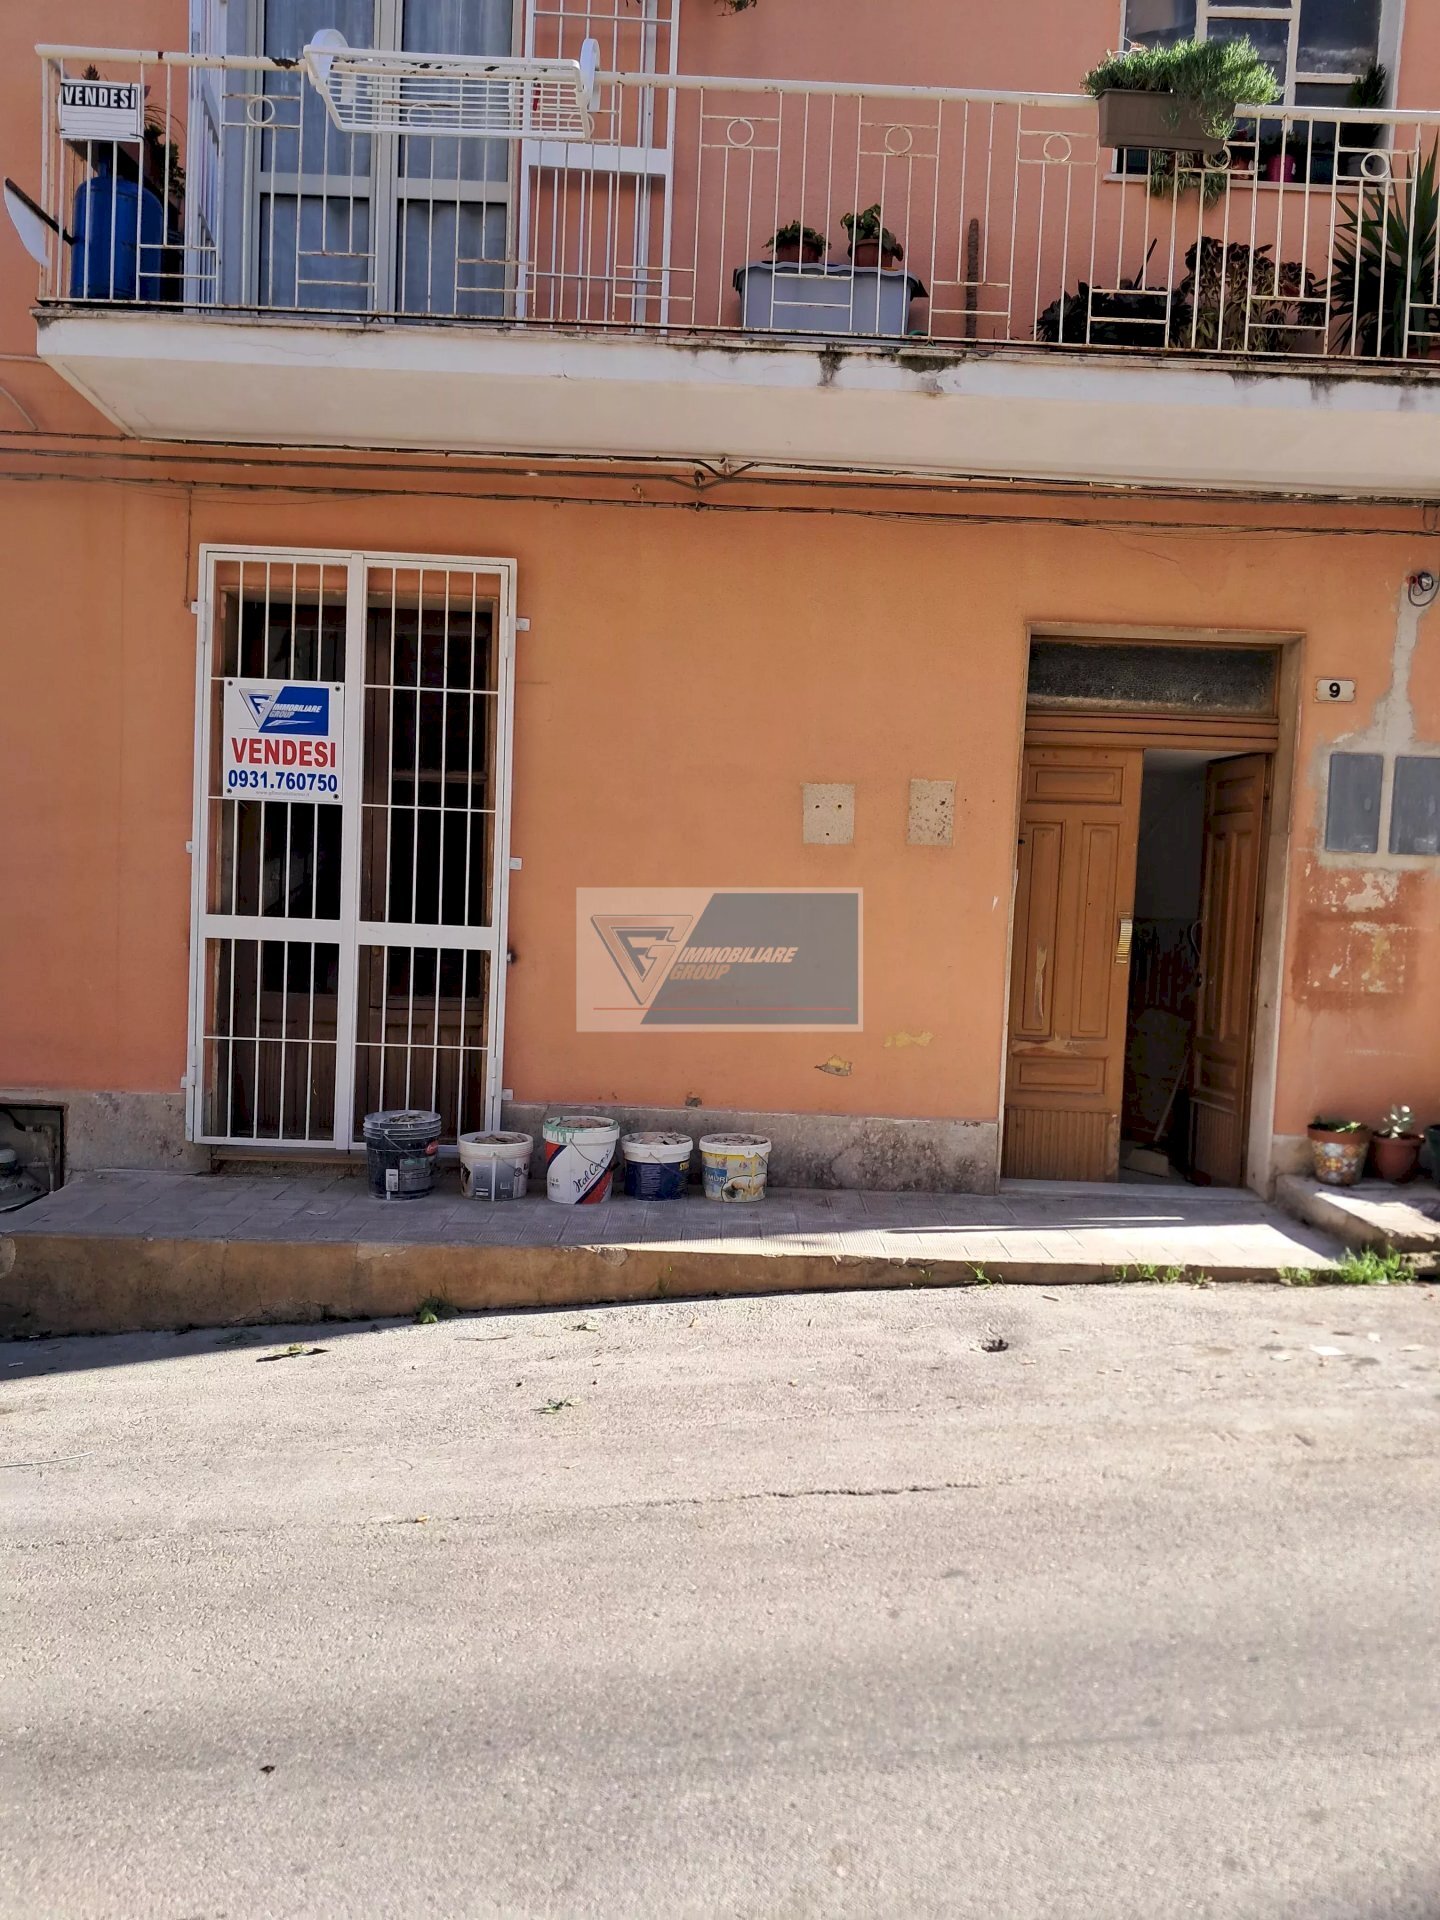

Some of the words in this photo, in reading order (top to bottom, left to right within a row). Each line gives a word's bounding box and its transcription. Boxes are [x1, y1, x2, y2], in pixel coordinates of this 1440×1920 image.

[64, 86, 135, 108] VENDESI
[1329, 682, 1341, 698] 9
[269, 710, 295, 718] GROUP
[272, 703, 322, 713] IMMOBILIARE
[231, 737, 336, 768] VENDESI
[228, 769, 338, 792] 0931.760750
